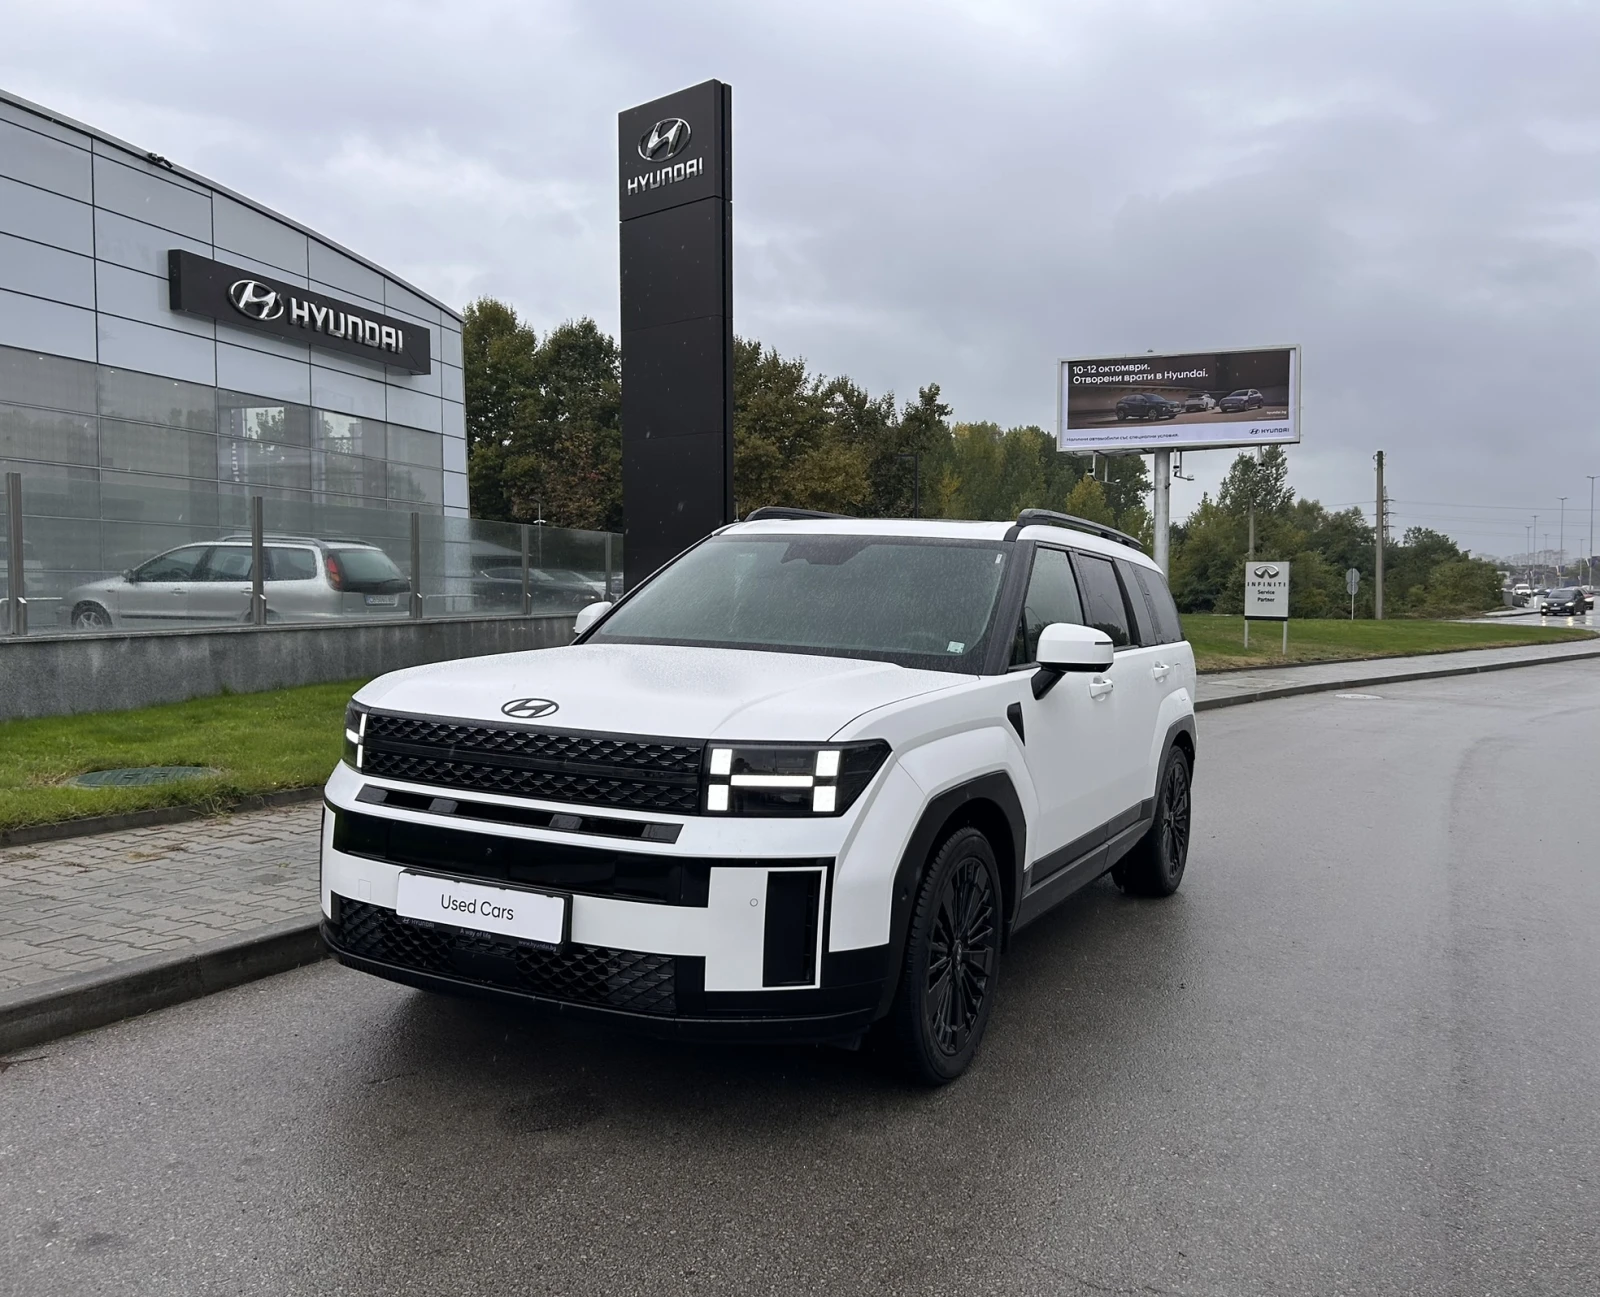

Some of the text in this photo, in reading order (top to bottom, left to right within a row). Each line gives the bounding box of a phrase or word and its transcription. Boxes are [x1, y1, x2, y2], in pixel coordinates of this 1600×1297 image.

[627, 157, 703, 196] HYUNDAI
[290, 297, 403, 354] HYUNDAI
[1072, 363, 1151, 375] 10-12 октомври.
[1072, 375, 1123, 385] Отворени
[1124, 373, 1155, 383] врати
[1164, 368, 1209, 380] Hyundai.
[440, 894, 515, 921] Used Cars
[411, 919, 435, 929] HYUNDAI
[465, 930, 476, 939] way
[481, 932, 492, 940] life
[518, 939, 557, 952] www.hyundai.bg
